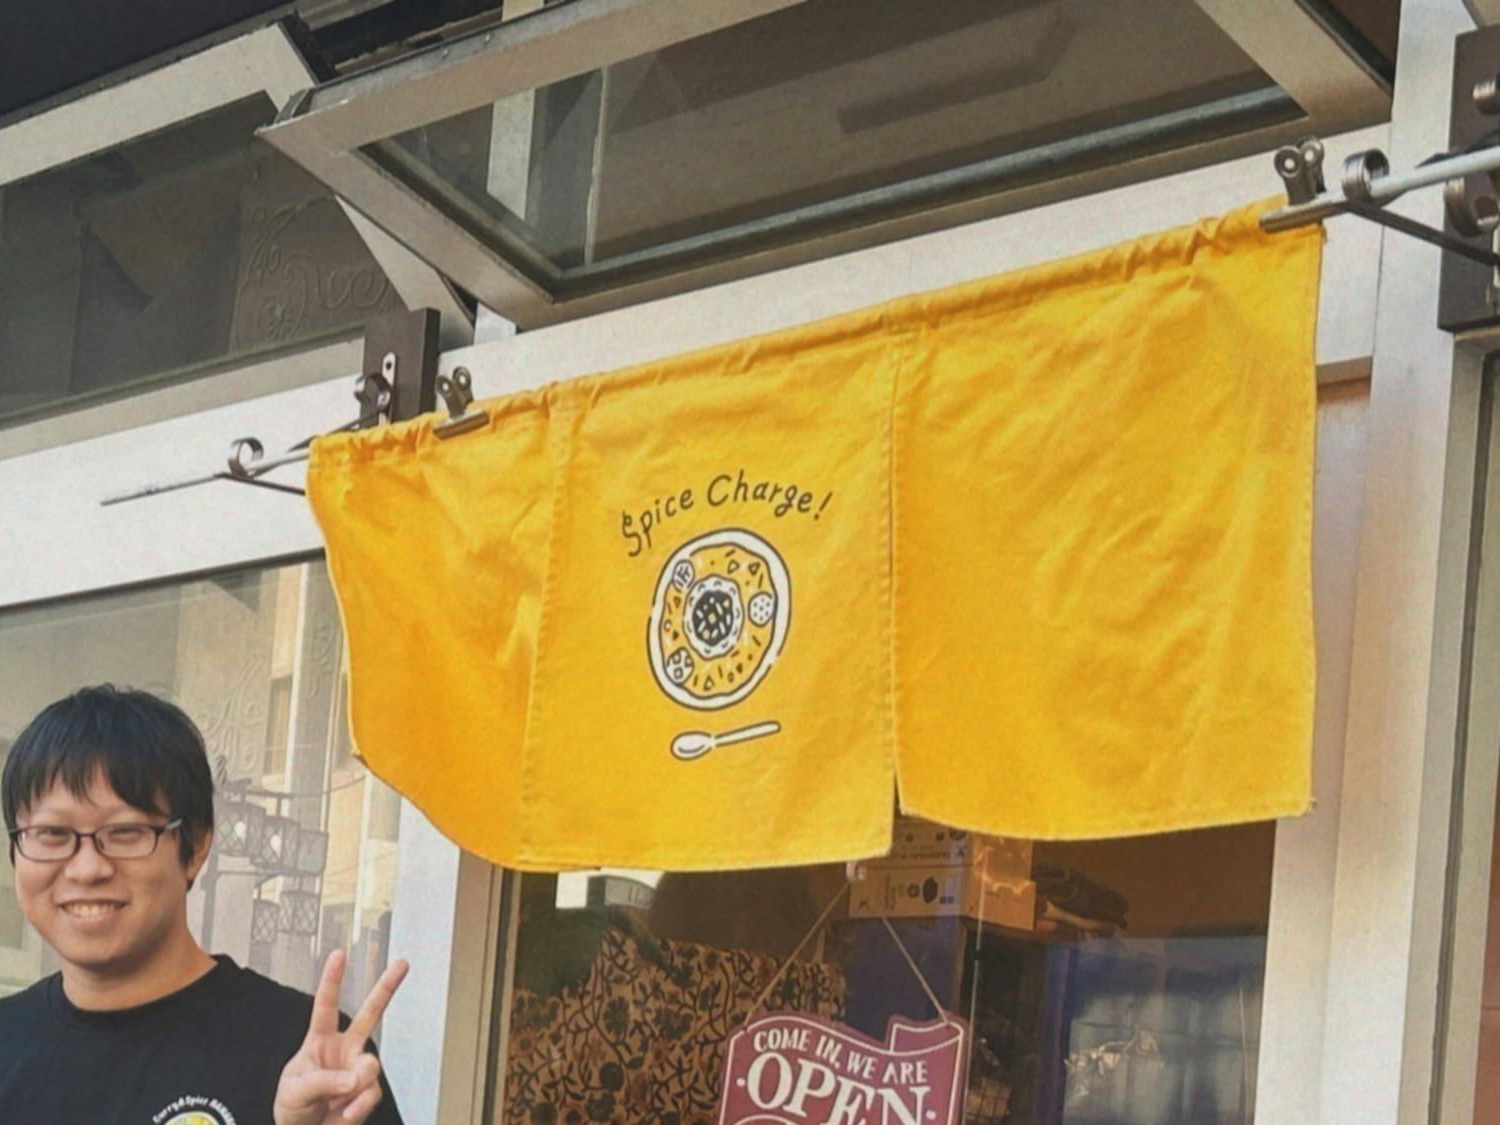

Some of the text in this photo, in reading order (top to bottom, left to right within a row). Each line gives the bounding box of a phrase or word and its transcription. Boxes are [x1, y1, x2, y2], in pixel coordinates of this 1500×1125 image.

[620, 469, 834, 557] Spice Charge!
[753, 1027, 811, 1053] COME
[846, 1050, 879, 1080] WE
[882, 1060, 929, 1085] ARE
